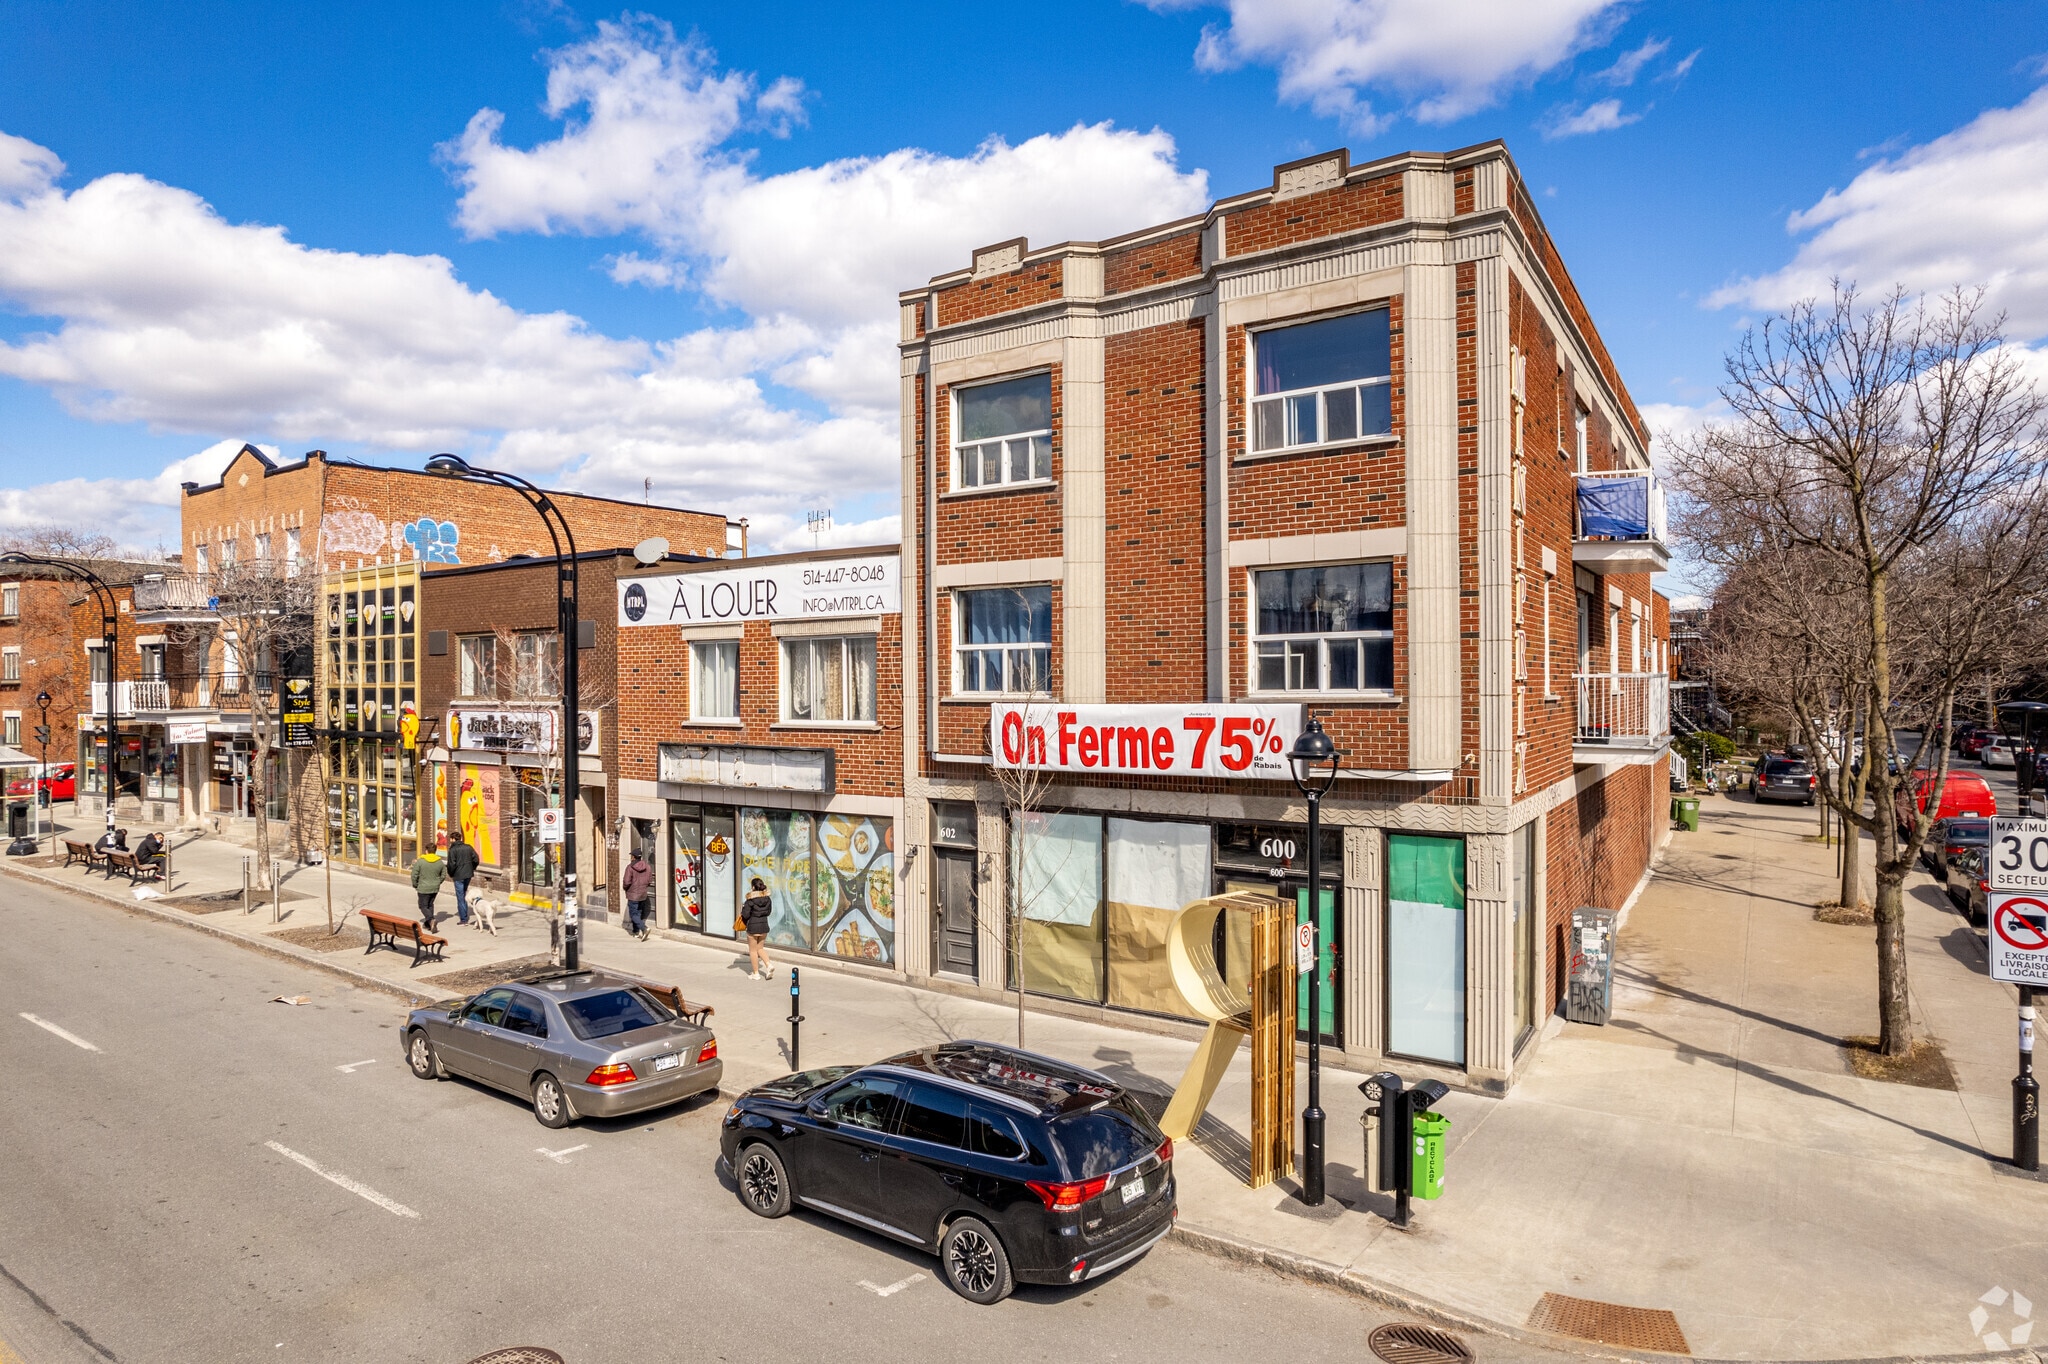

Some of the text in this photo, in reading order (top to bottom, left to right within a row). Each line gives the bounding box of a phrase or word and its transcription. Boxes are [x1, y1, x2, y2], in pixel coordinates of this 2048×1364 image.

[803, 565, 885, 586] 514-447-8048
[669, 579, 778, 620] À LOUER
[802, 595, 885, 613] INFO@MTRPL.CA
[293, 699, 311, 708] Style
[467, 714, 500, 734] Jack
[1002, 711, 1283, 771] On Ferme 75%
[940, 827, 956, 838] 602
[1996, 822, 2047, 833] MAXIMU
[1261, 838, 1295, 859] 600
[1999, 835, 2048, 872] 30
[743, 853, 810, 874] OUVETURE
[1270, 868, 1284, 877] 600
[1998, 874, 2047, 886] SECTEU
[2000, 960, 2048, 971] LIVRAISO
